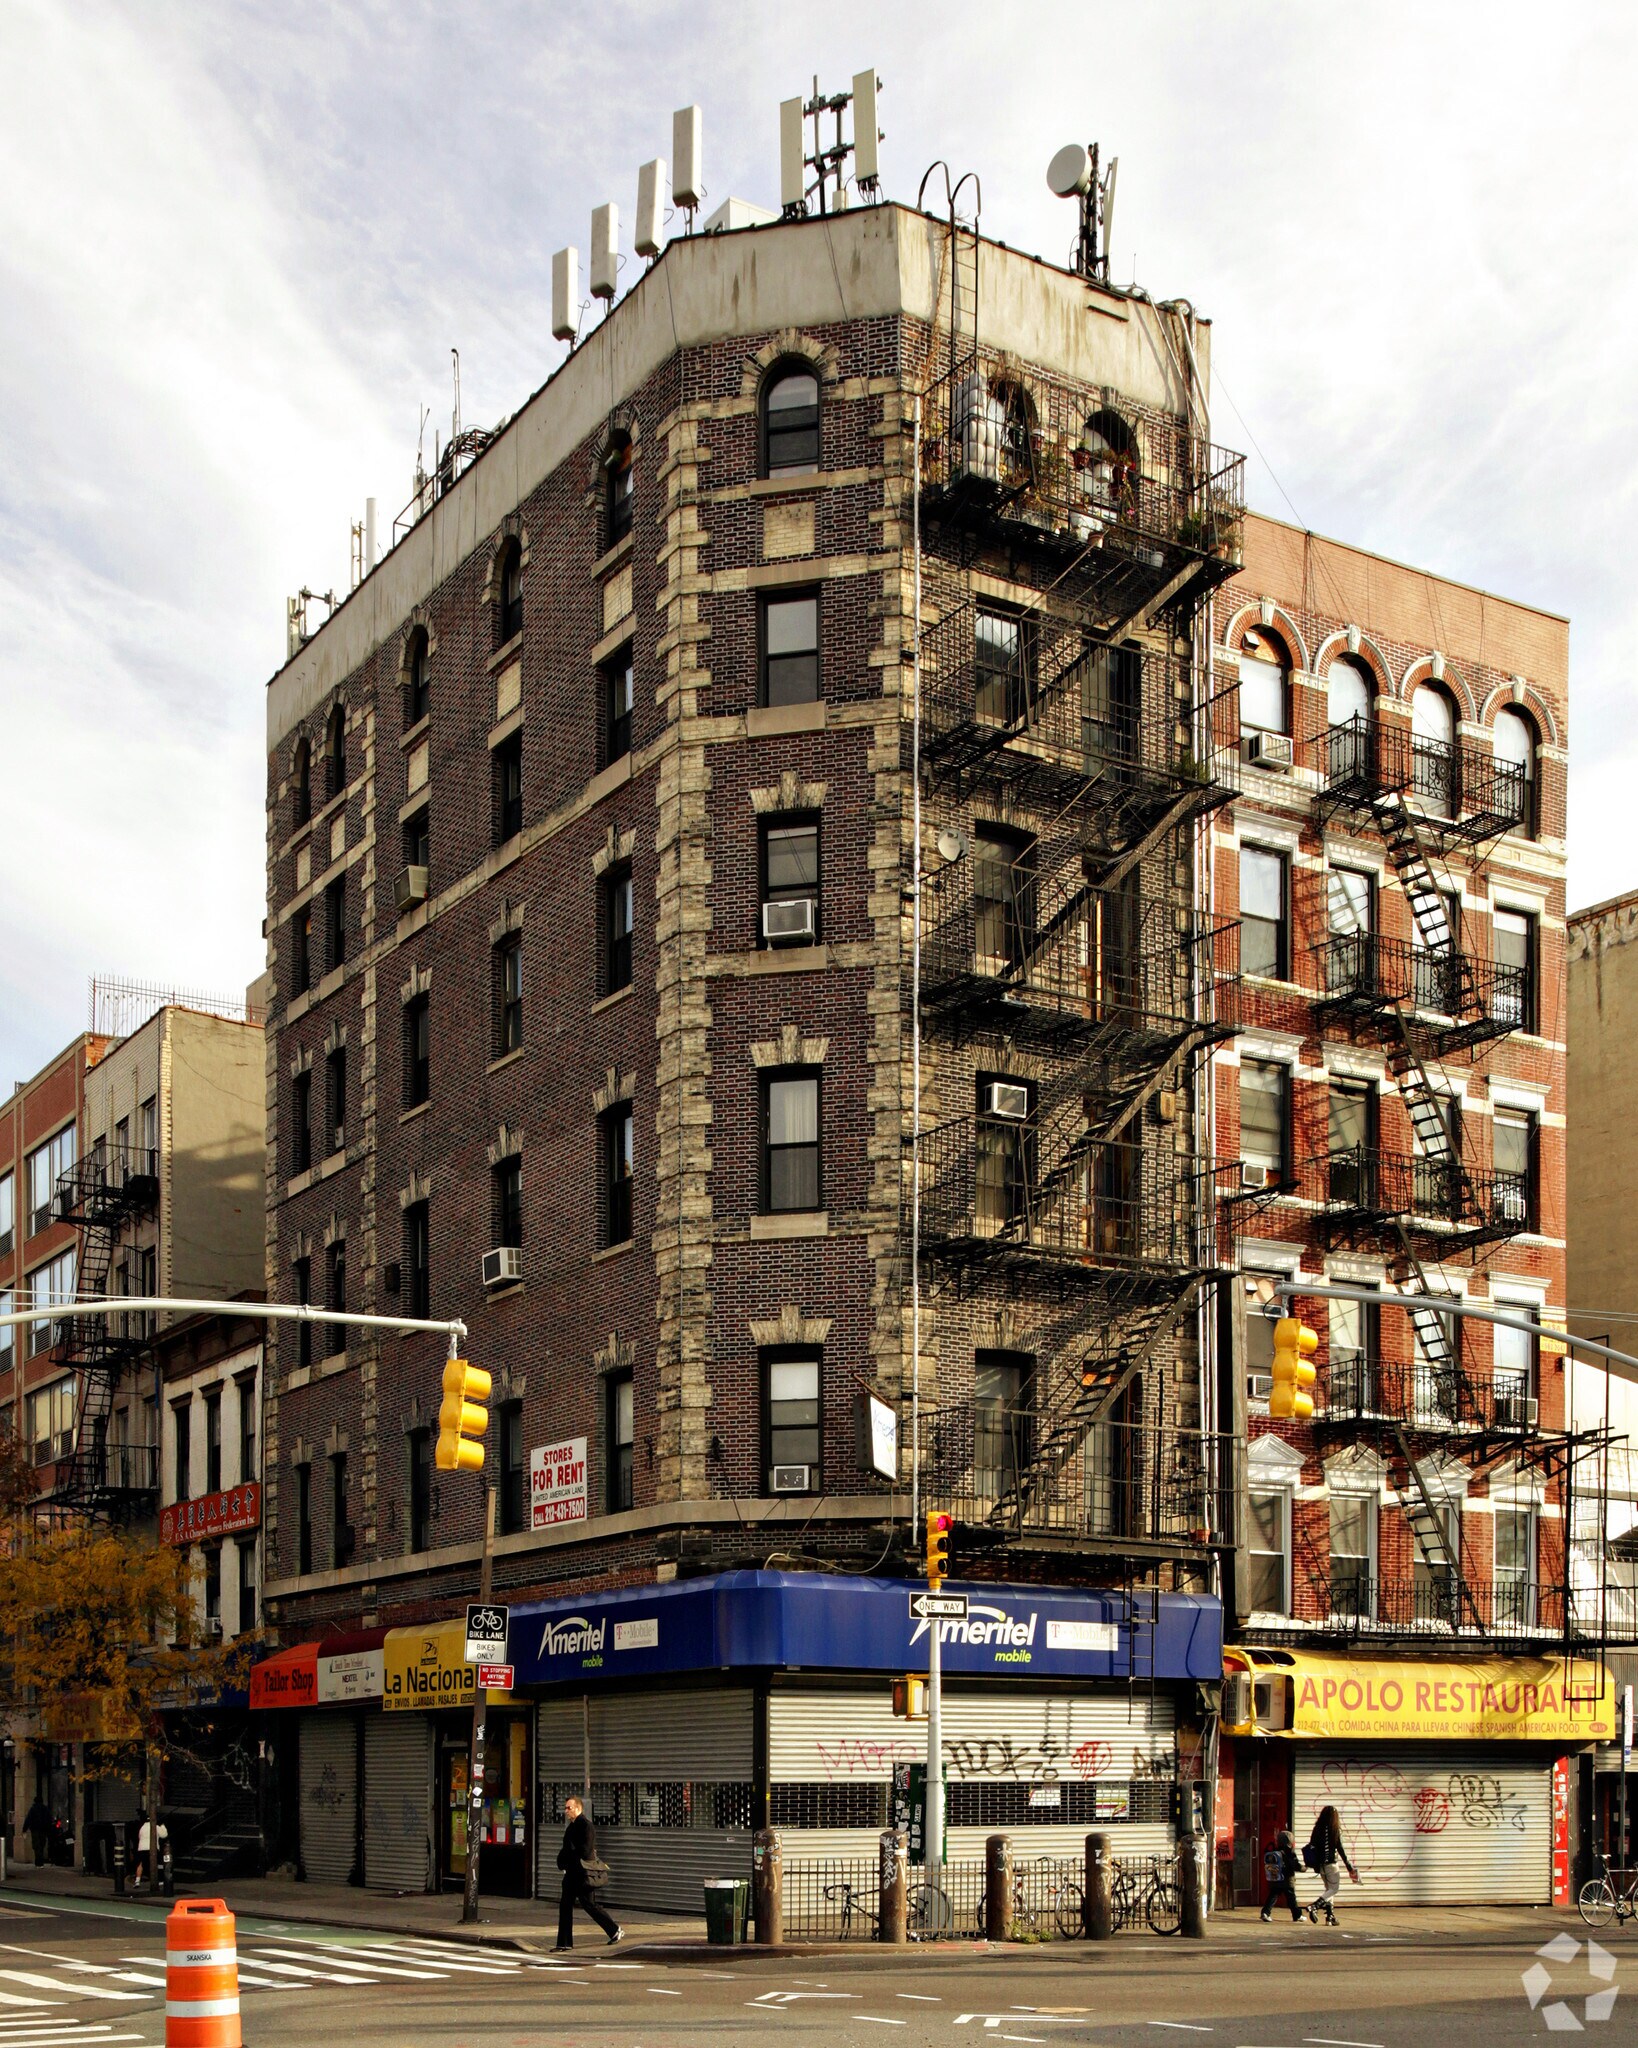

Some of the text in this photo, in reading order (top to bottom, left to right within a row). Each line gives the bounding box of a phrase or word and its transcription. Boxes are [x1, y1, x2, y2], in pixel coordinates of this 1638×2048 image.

[543, 1446, 573, 1466] STORES
[532, 1461, 585, 1492] FOR RENT
[534, 1485, 585, 1502] UNITED AMERICAN LAND
[534, 1499, 584, 1525] CALL 212-431-7500
[189, 1528, 206, 1539] Chinese
[222, 1518, 246, 1531] Federation
[919, 1602, 960, 1611] ONE WAY
[469, 1631, 504, 1640] BIKE LANE
[538, 1617, 606, 1660] Ameritel
[476, 1644, 496, 1652] BIKES
[994, 1649, 1032, 1663] mobile
[582, 1654, 604, 1668] mobile
[264, 1668, 314, 1695] Tailor Shop
[384, 1664, 474, 1694] La Naciona
[1298, 1677, 1596, 1714] APOLO RESTAURANT
[1339, 1720, 1373, 1732] COMIDA
[1374, 1721, 1400, 1732] CHINA
[1401, 1721, 1421, 1732] PARA
[1423, 1722, 1449, 1733] LLEVAR
[1452, 1722, 1484, 1733] CHINESE
[1486, 1722, 1517, 1733] SPANISH
[1519, 1722, 1556, 1733] AMERICAN
[1559, 1722, 1580, 1733] FOOD
[186, 1954, 212, 1962] SKANSKA
